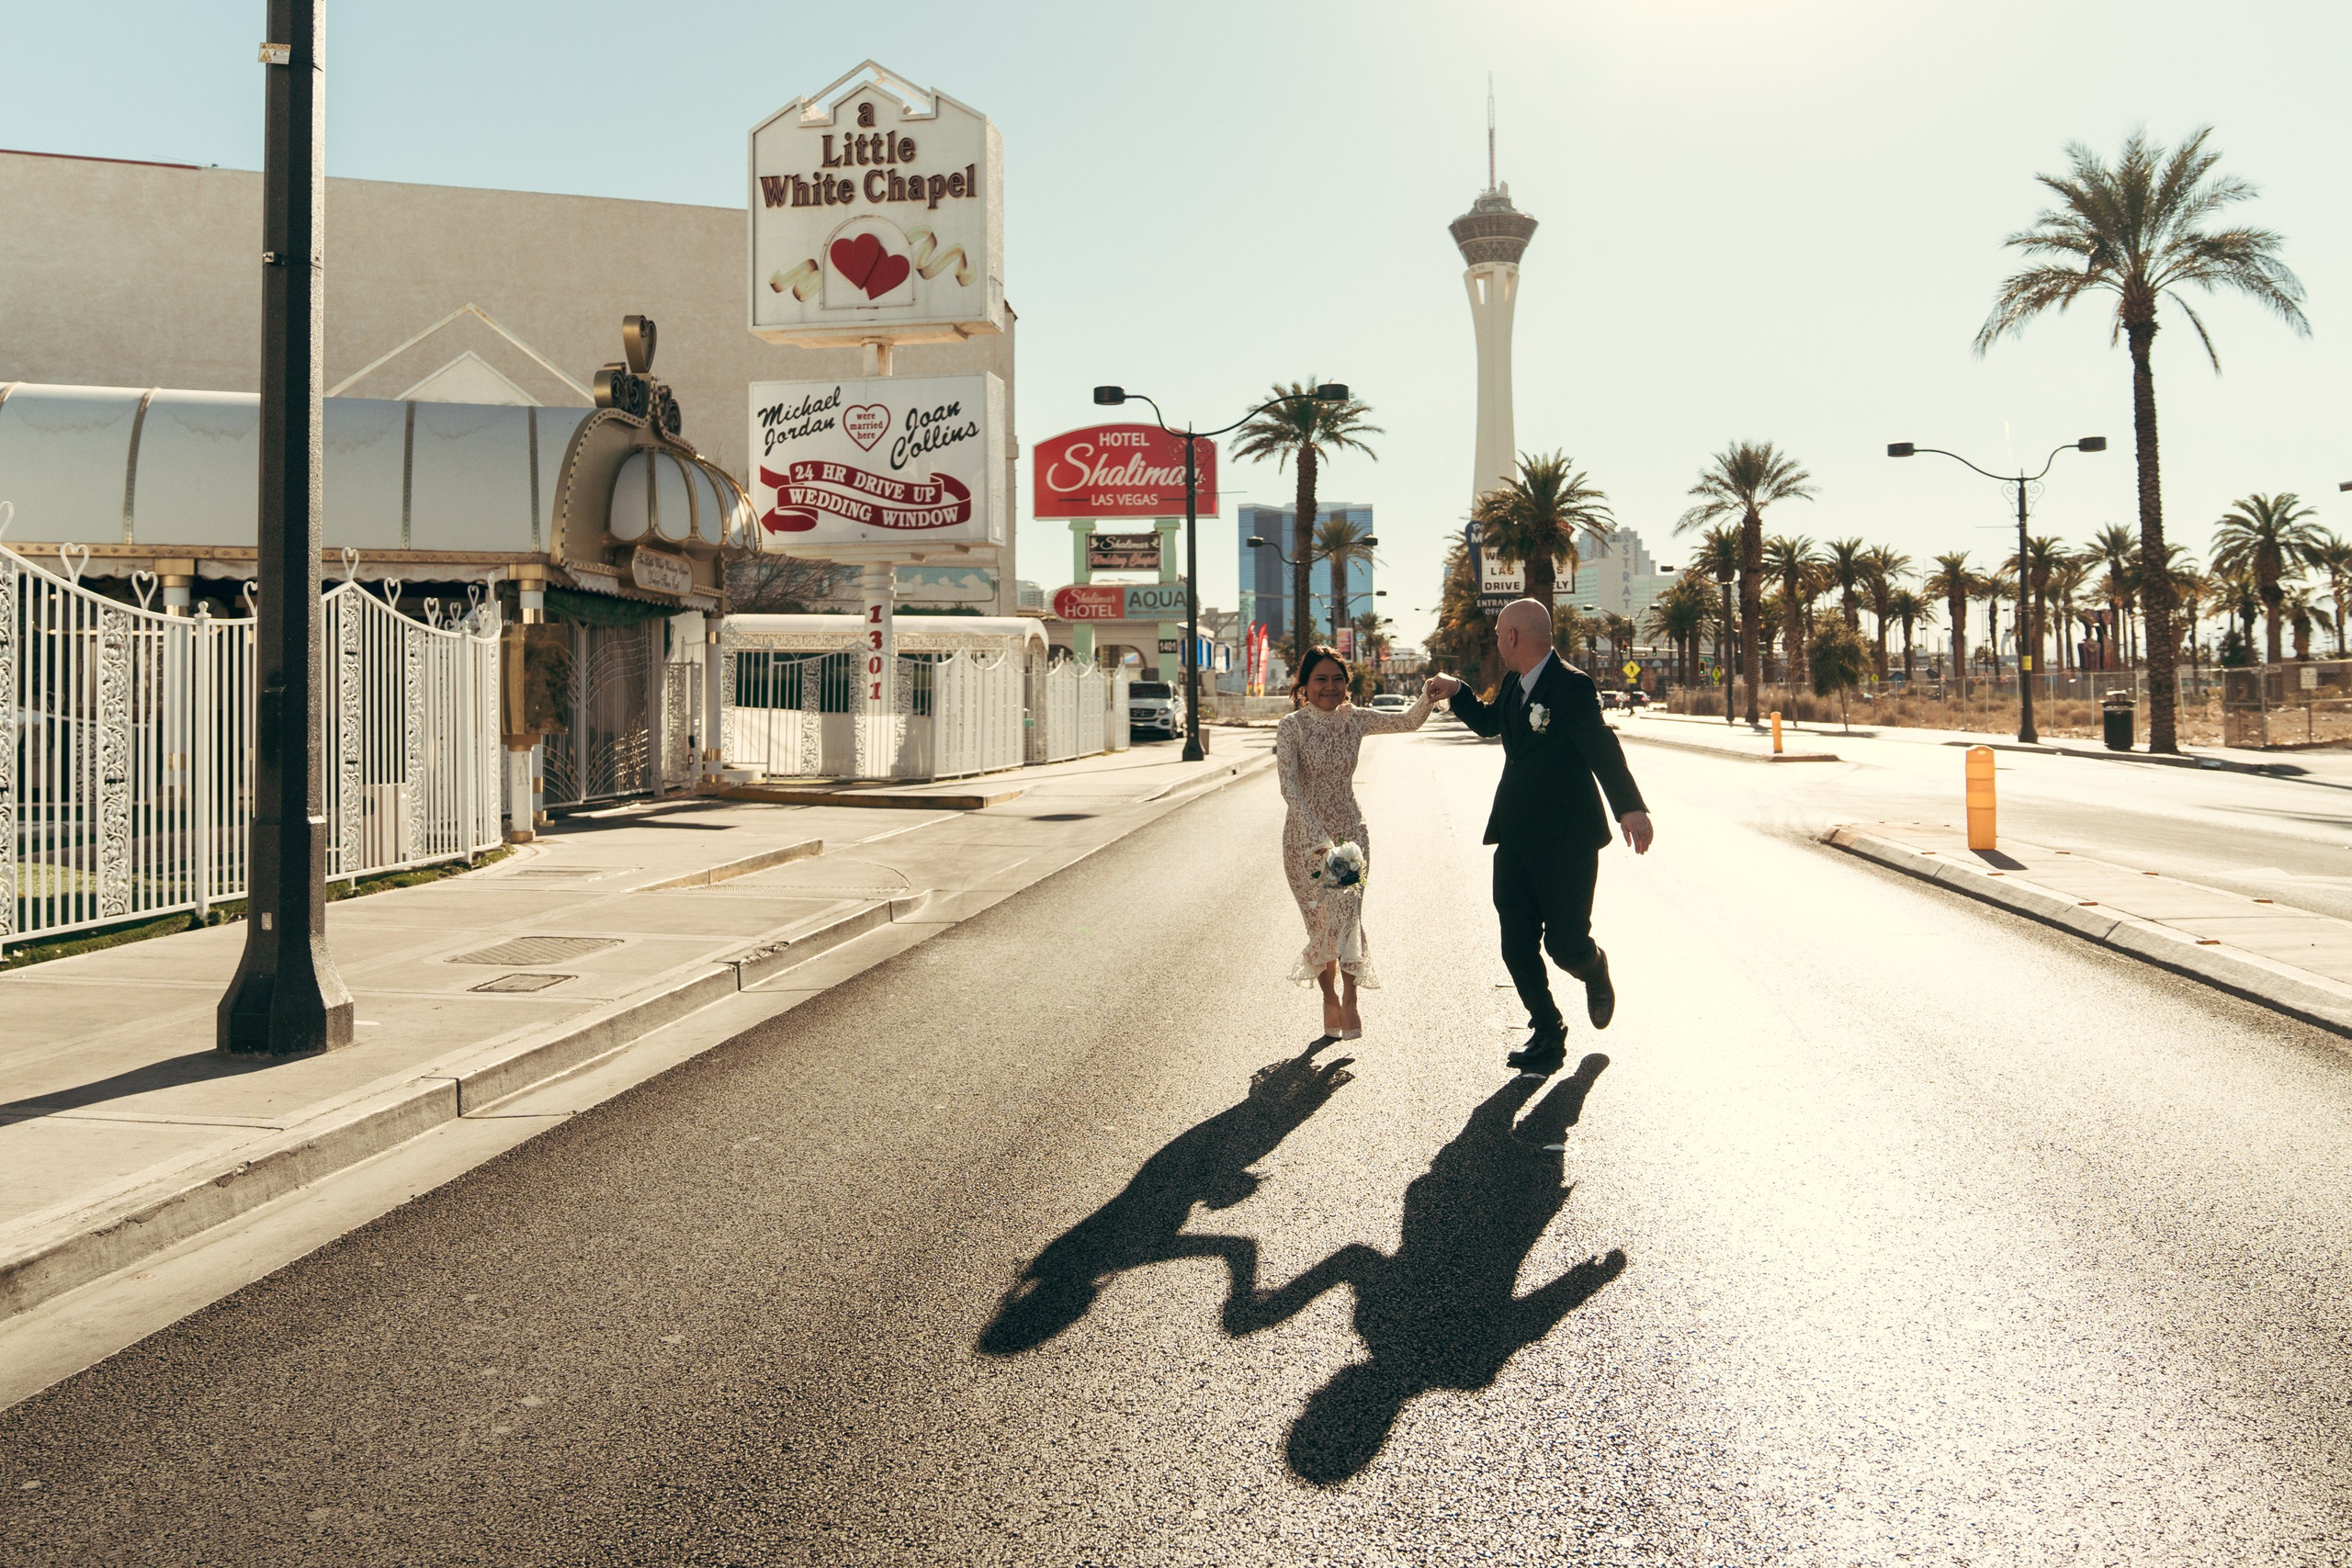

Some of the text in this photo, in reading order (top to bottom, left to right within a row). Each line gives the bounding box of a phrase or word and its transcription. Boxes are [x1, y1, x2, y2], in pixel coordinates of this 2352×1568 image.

[857, 102, 876, 128] a
[821, 130, 916, 168] Little
[760, 164, 977, 209] White Chapel
[757, 386, 842, 428] Michael
[850, 421, 883, 430] married
[856, 412, 876, 421] were
[906, 401, 961, 444] Joan
[764, 416, 835, 457] Jordan
[857, 431, 876, 439] here
[1099, 433, 1150, 446] HOTEL
[890, 422, 980, 470] Collins
[795, 464, 936, 502] 24 HR DRIVE UP
[788, 488, 959, 527] WEDDING WINDOW
[1091, 493, 1159, 506] LAS VEGAS
[1100, 536, 1150, 550] Shalimar
[1490, 567, 1515, 576] LAS
[1622, 544, 1632, 610] STRAT
[1485, 581, 1521, 591] DRIVE
[1064, 589, 1117, 605] Shalimar
[1128, 591, 1187, 609] AQUA
[1476, 598, 1517, 607] ENTRAN
[1065, 604, 1117, 617] HOTEL
[868, 604, 883, 700] 1301
